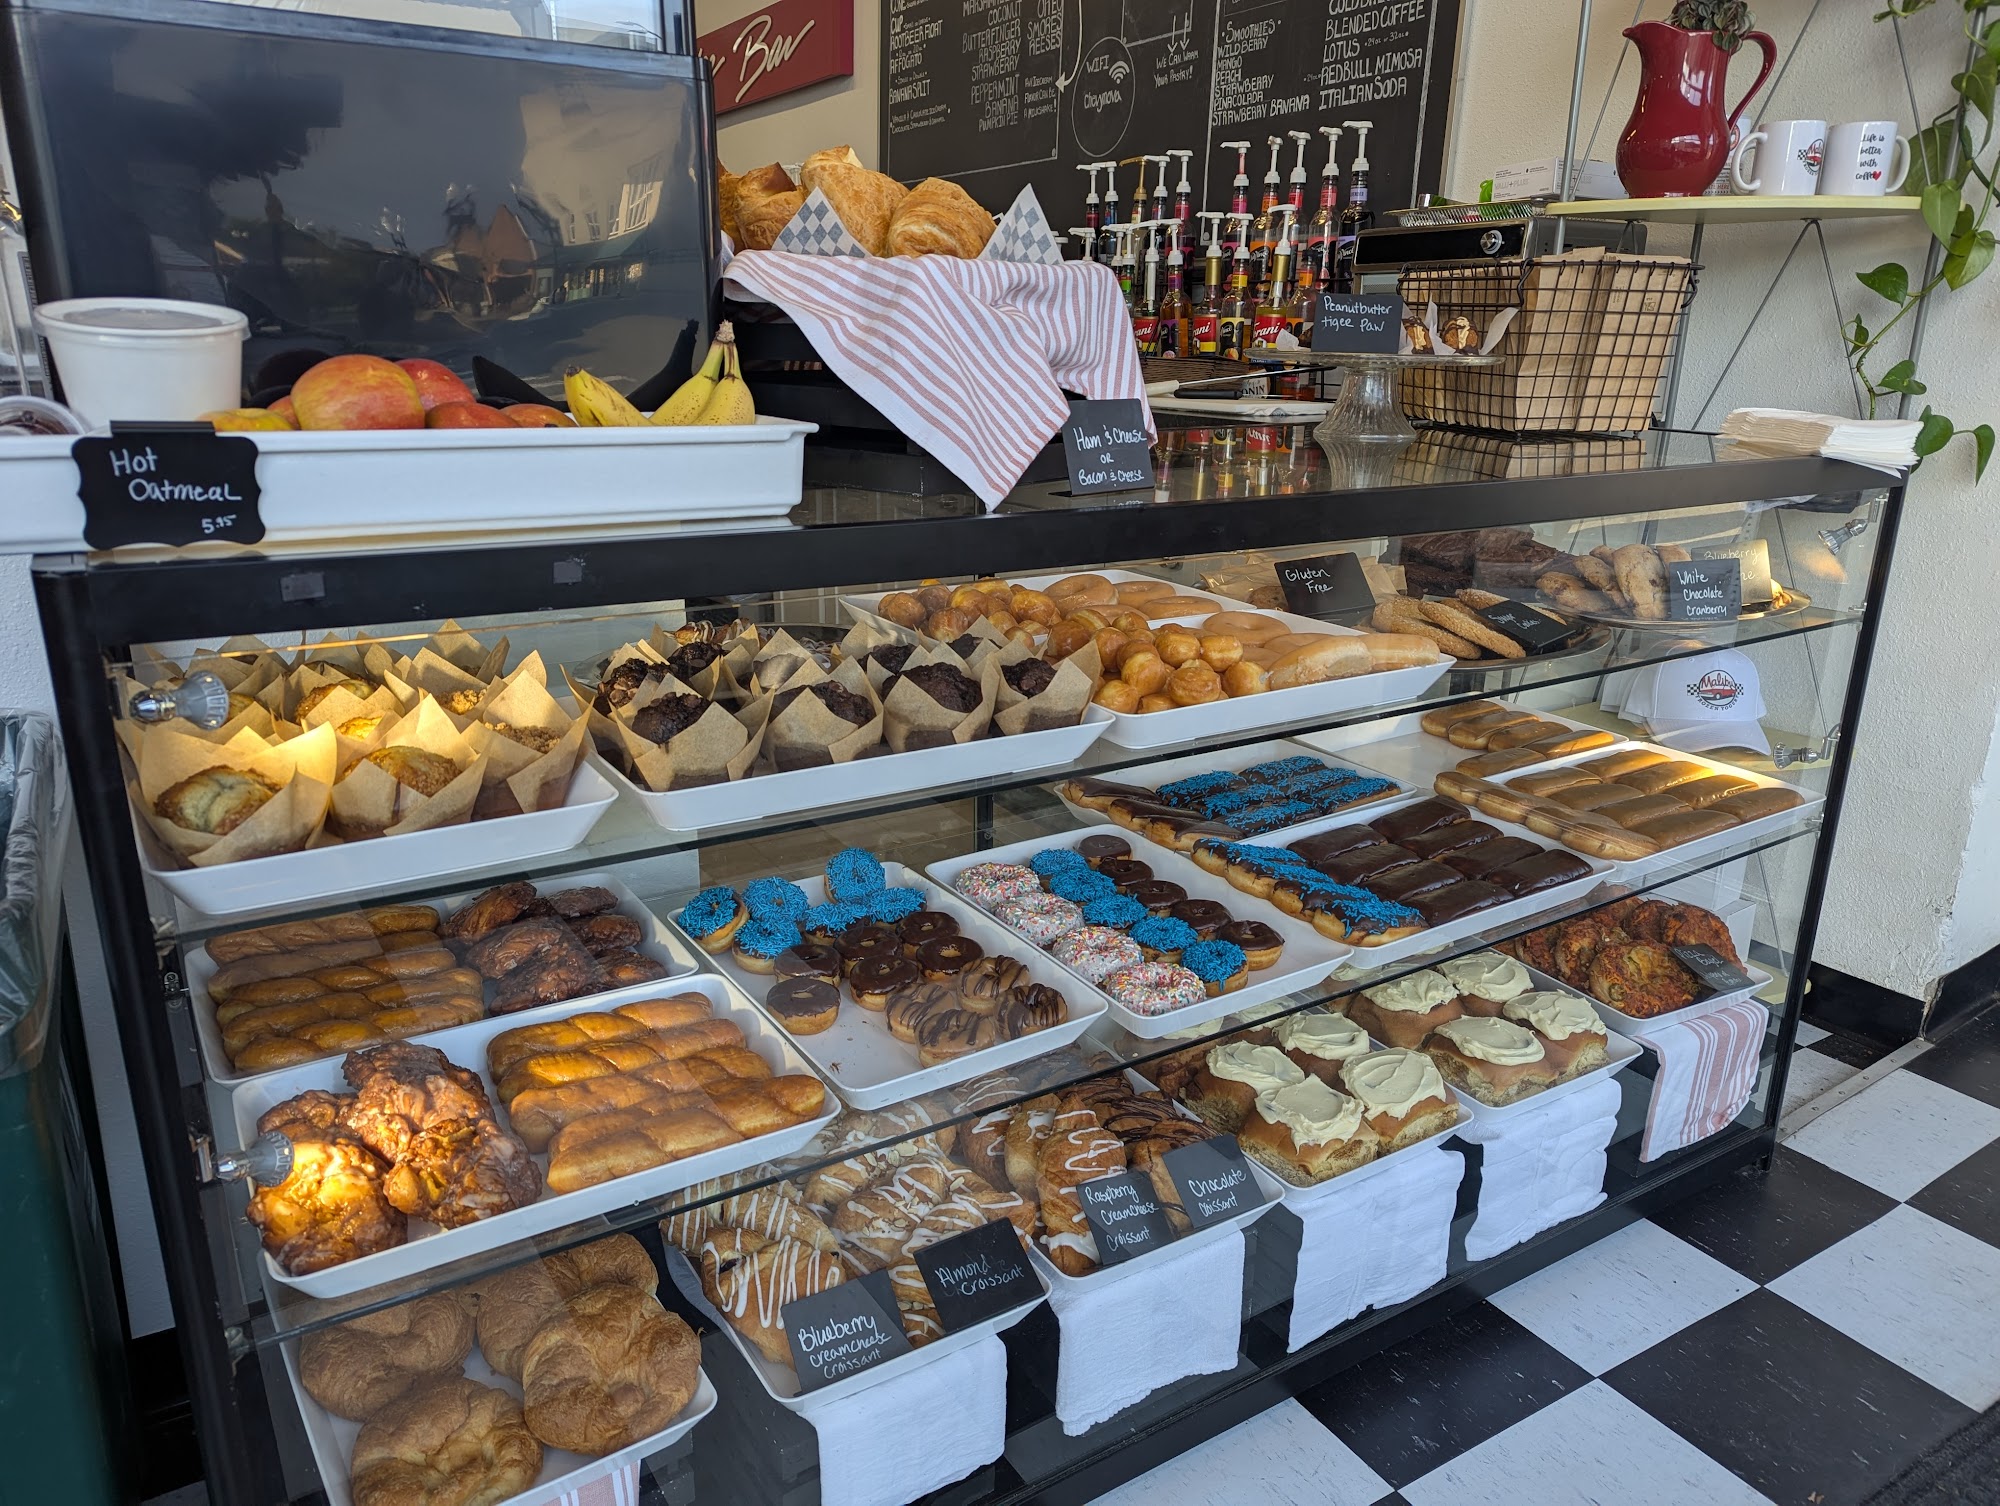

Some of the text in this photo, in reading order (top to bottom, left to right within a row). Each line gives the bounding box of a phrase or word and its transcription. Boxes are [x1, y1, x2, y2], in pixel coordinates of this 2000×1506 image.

[1325, 0, 1426, 41] BLENDED COFFEE
[732, 14, 815, 103] Bar
[1323, 38, 1361, 63] LOTUS
[1374, 48, 1423, 75] MIMOSA
[1269, 94, 1311, 117] BANANA
[1319, 76, 1408, 111] ITALIAN SODA
[1073, 427, 1102, 451] Ham
[109, 447, 158, 477] Hot
[1078, 469, 1107, 486] Bacon
[1285, 567, 1331, 581] Gluten
[1306, 580, 1333, 594] Free
[798, 1315, 879, 1352] Blueberry
